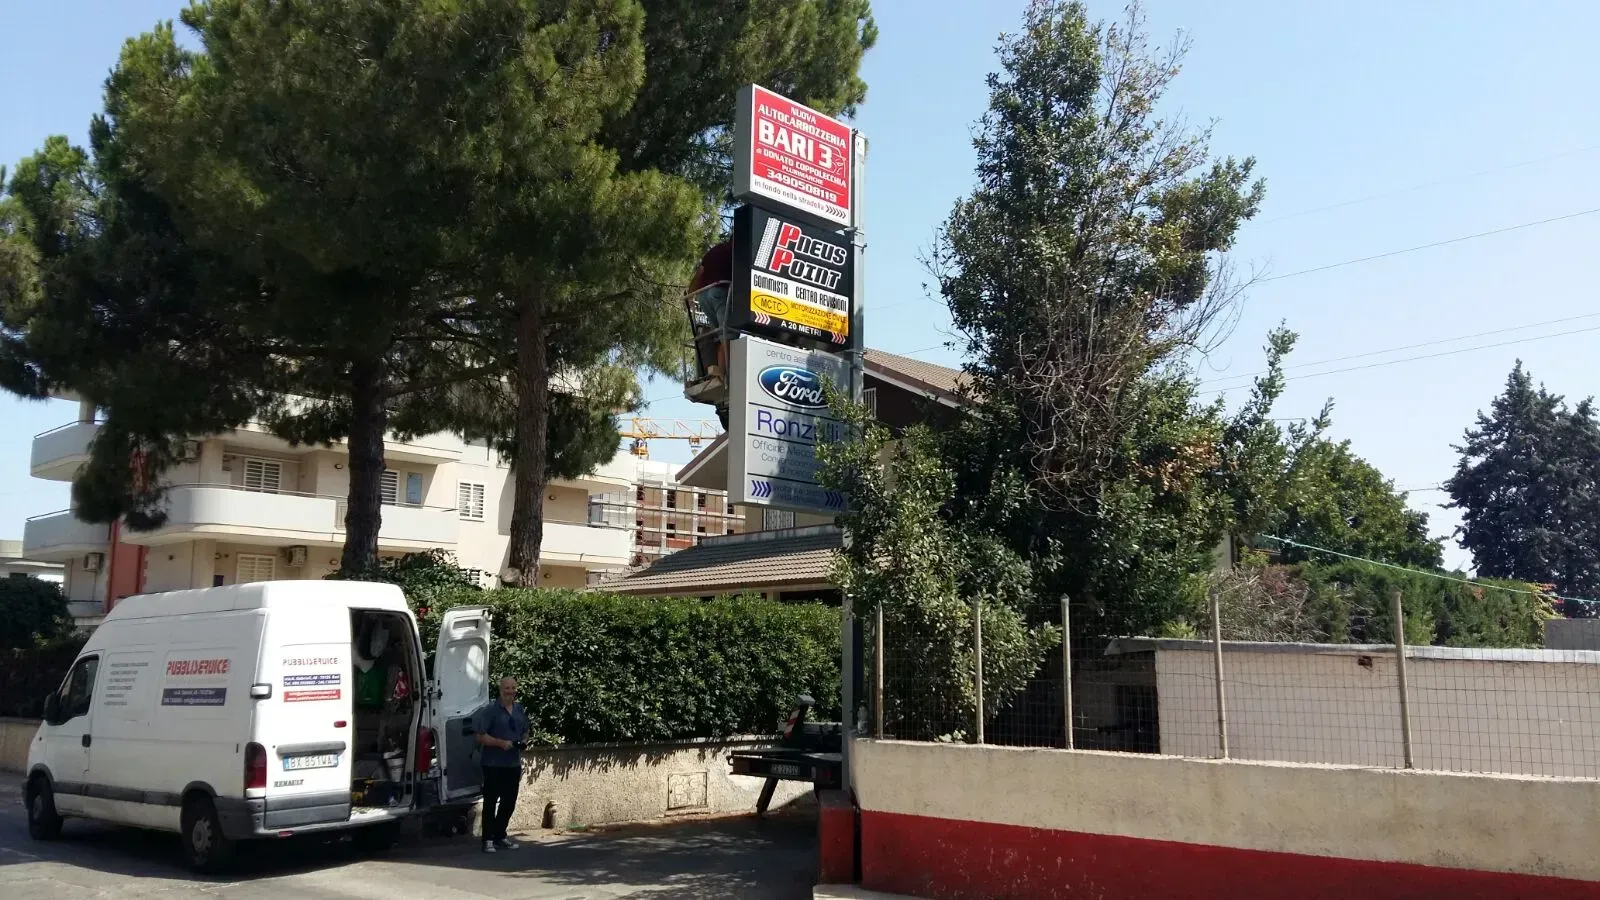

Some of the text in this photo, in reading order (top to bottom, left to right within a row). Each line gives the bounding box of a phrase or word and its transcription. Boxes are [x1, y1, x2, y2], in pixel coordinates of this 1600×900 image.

[758, 104, 846, 149] AUTOCARROZZERIA
[791, 107, 816, 124] NUOVA
[758, 118, 833, 169] BARI 3
[763, 149, 794, 167] DONATO
[796, 161, 846, 188] COPPOLECCHIA
[754, 179, 761, 187] in
[762, 182, 781, 194] fondo
[783, 190, 797, 200] nella
[767, 168, 837, 202] 3490508119
[753, 274, 847, 312] GOMMISTA CENTRO REVISIONI
[760, 298, 782, 312] MCTC
[788, 321, 797, 330] 20
[798, 325, 822, 336] METRI
[766, 350, 791, 360] centro
[774, 370, 824, 404] Ford
[273, 779, 304, 788] RENAULT
